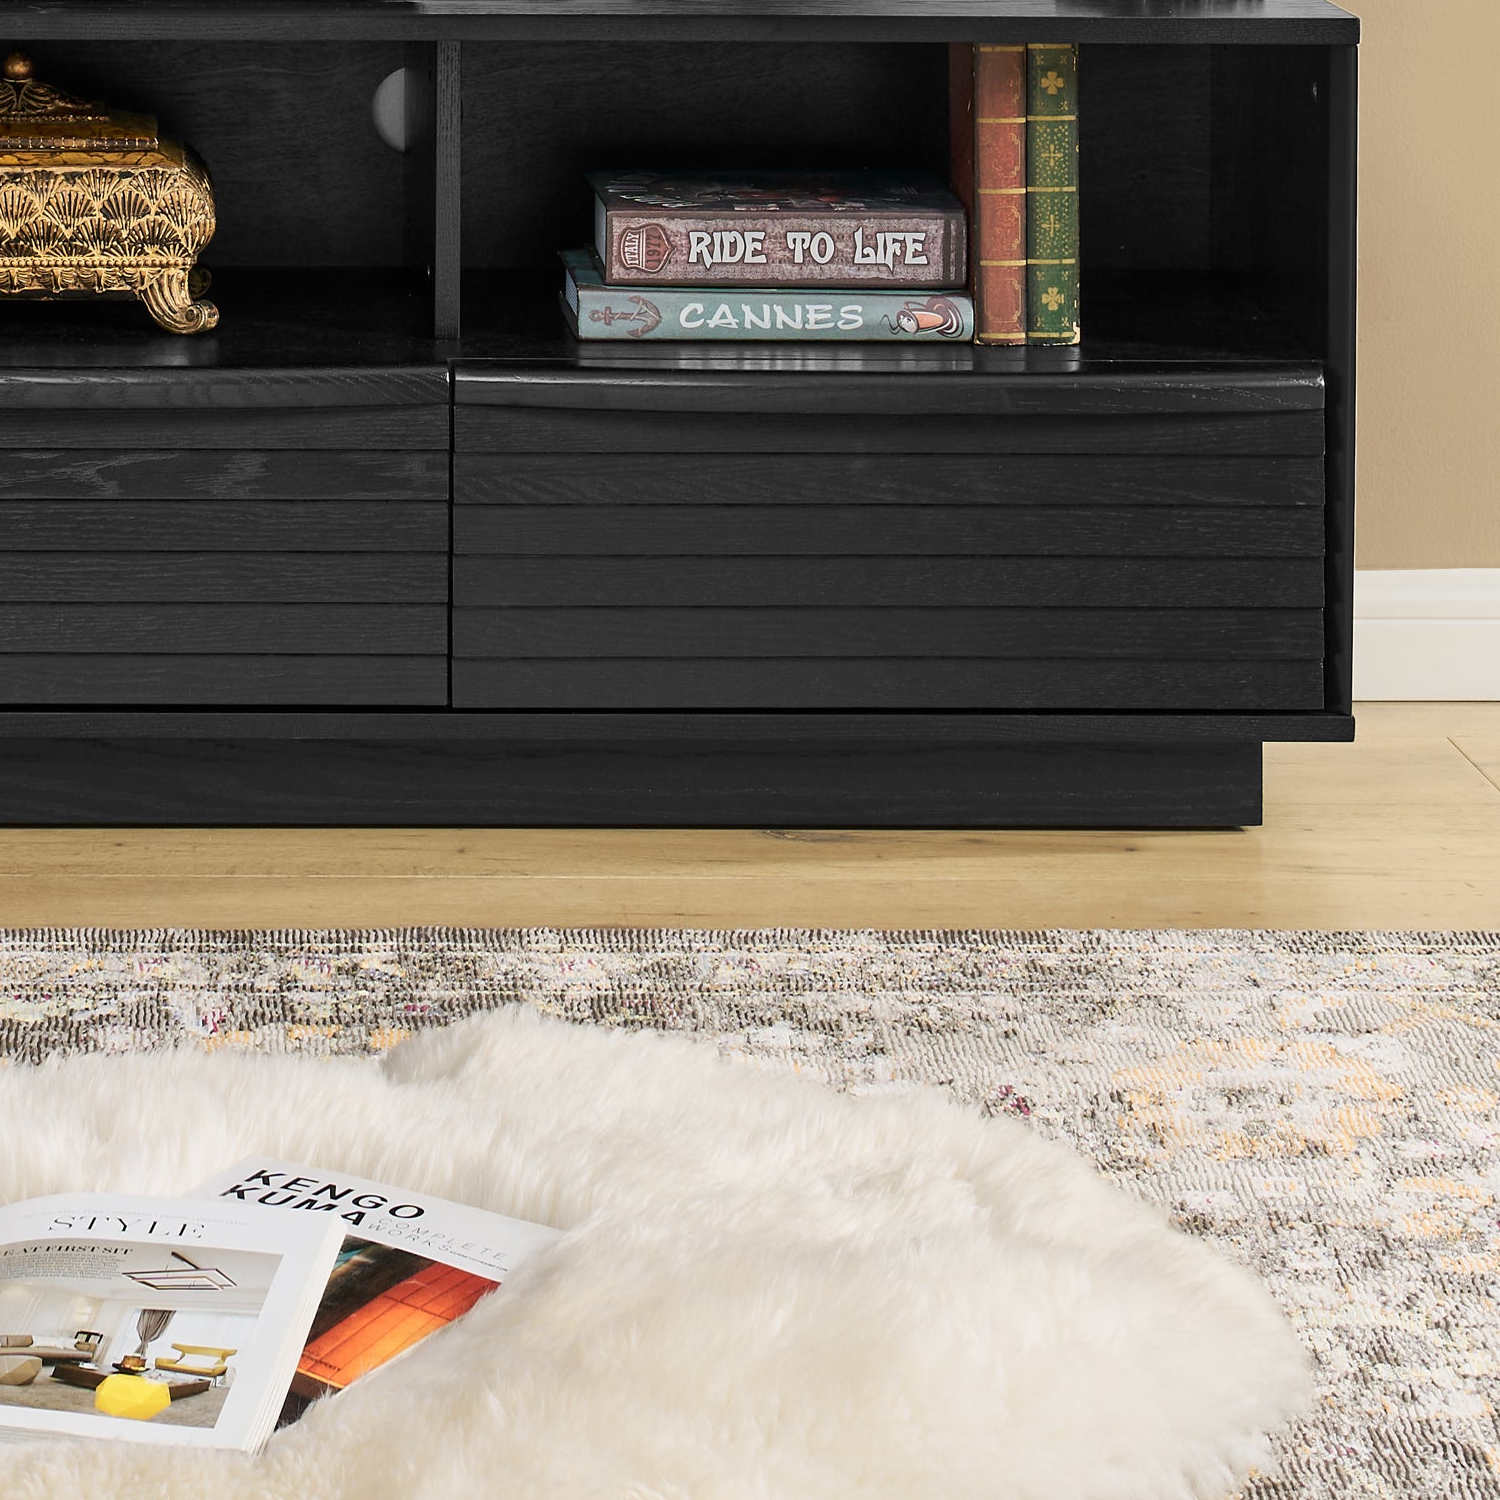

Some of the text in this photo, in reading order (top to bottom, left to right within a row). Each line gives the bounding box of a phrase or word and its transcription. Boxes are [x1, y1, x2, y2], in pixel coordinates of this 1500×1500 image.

[624, 232, 639, 265] ITALY
[646, 233, 661, 264] 1977
[688, 227, 931, 276] RIDE TO LIFE
[678, 302, 864, 330] CANNES
[219, 1184, 368, 1227] KUMA
[244, 1168, 426, 1220] KENGO
[49, 1215, 206, 1240] STYLE
[368, 1222, 453, 1252] WORKS
[378, 1217, 509, 1261] COMPLETE
[18, 1245, 44, 1254] AT
[45, 1244, 100, 1253] FIRST
